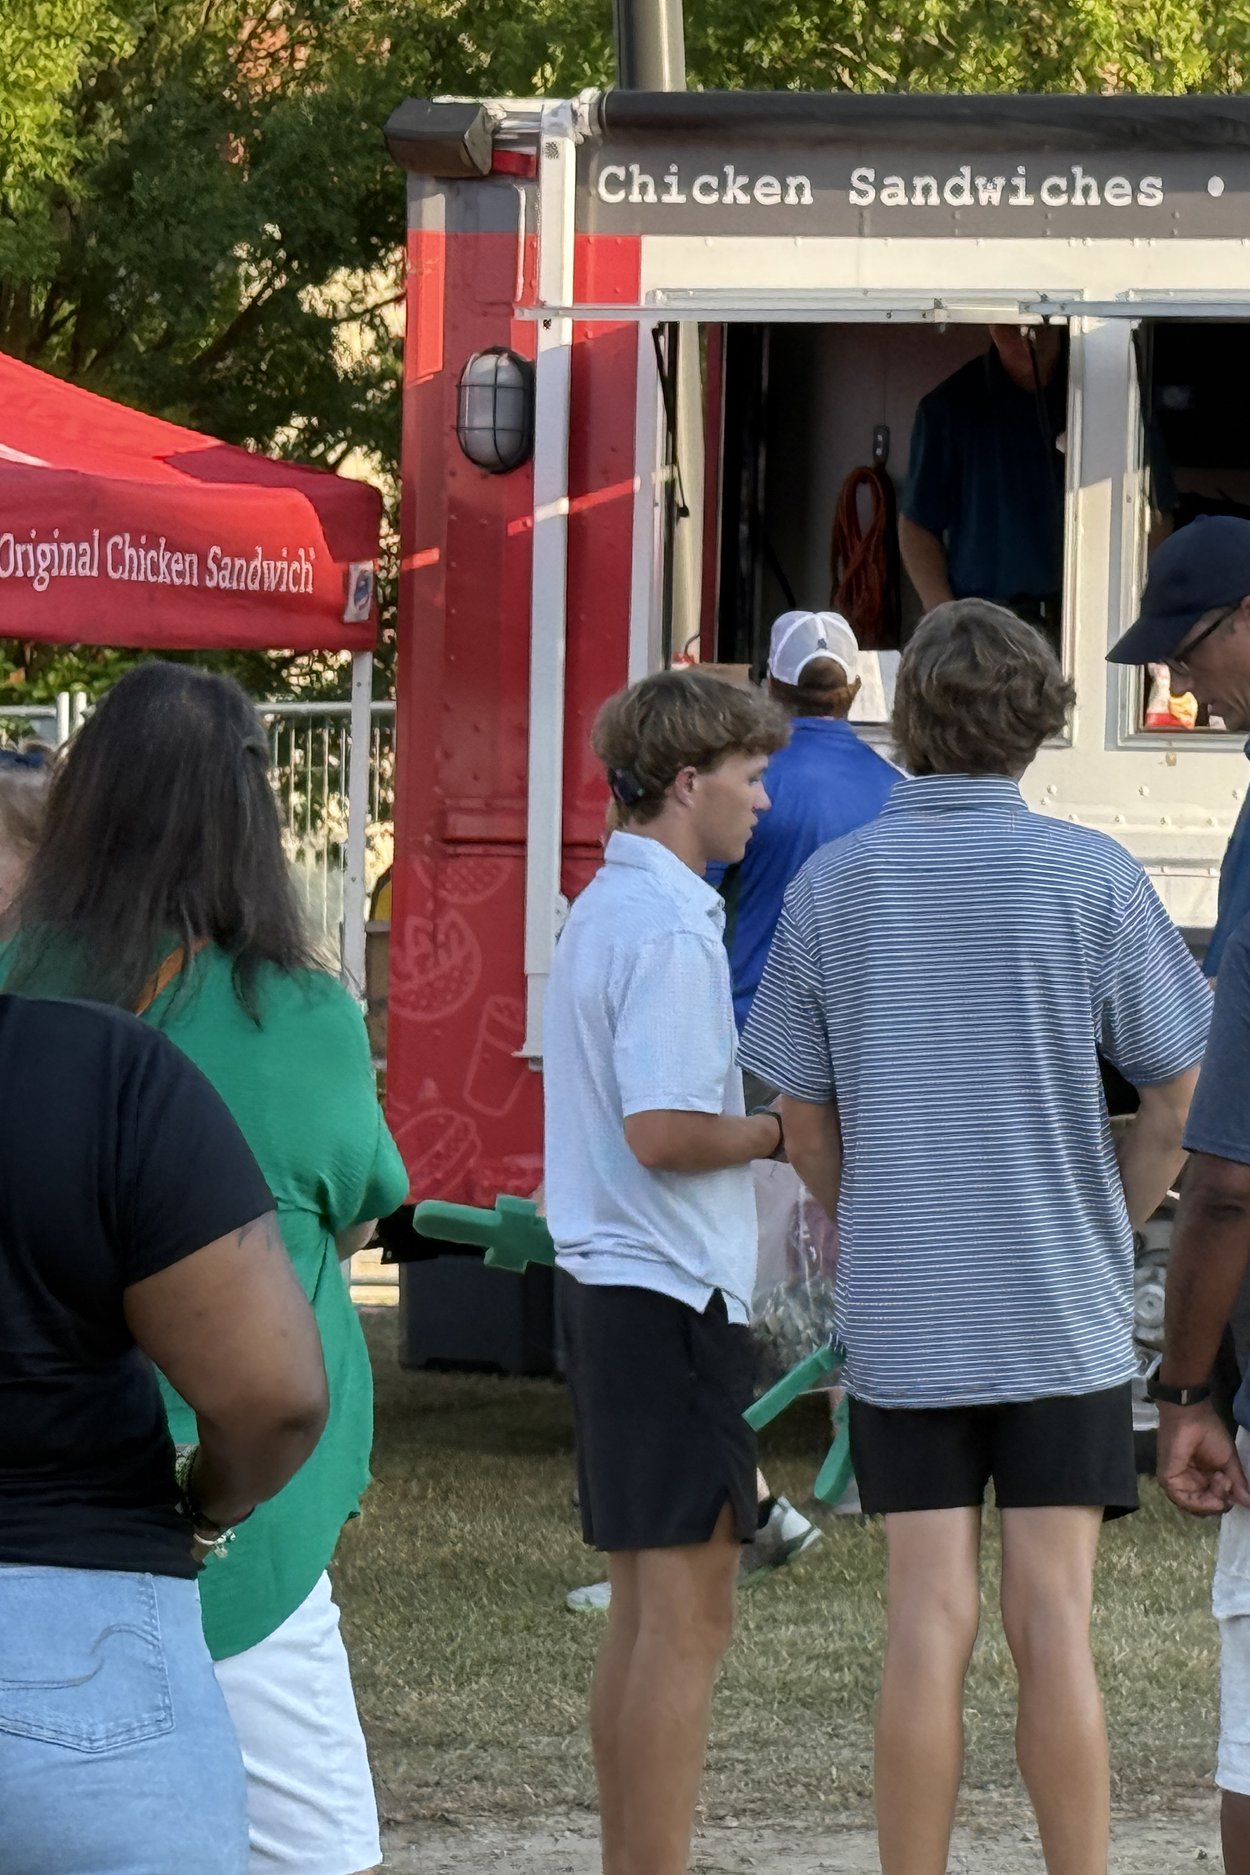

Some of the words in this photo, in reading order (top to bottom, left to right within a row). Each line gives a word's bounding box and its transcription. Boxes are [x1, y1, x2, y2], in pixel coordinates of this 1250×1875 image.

[597, 163, 814, 205] Chicken
[848, 165, 1165, 207] Sandwiches
[0, 528, 100, 591] Original
[107, 532, 199, 586] Chicken
[206, 545, 314, 594] Sandwich
